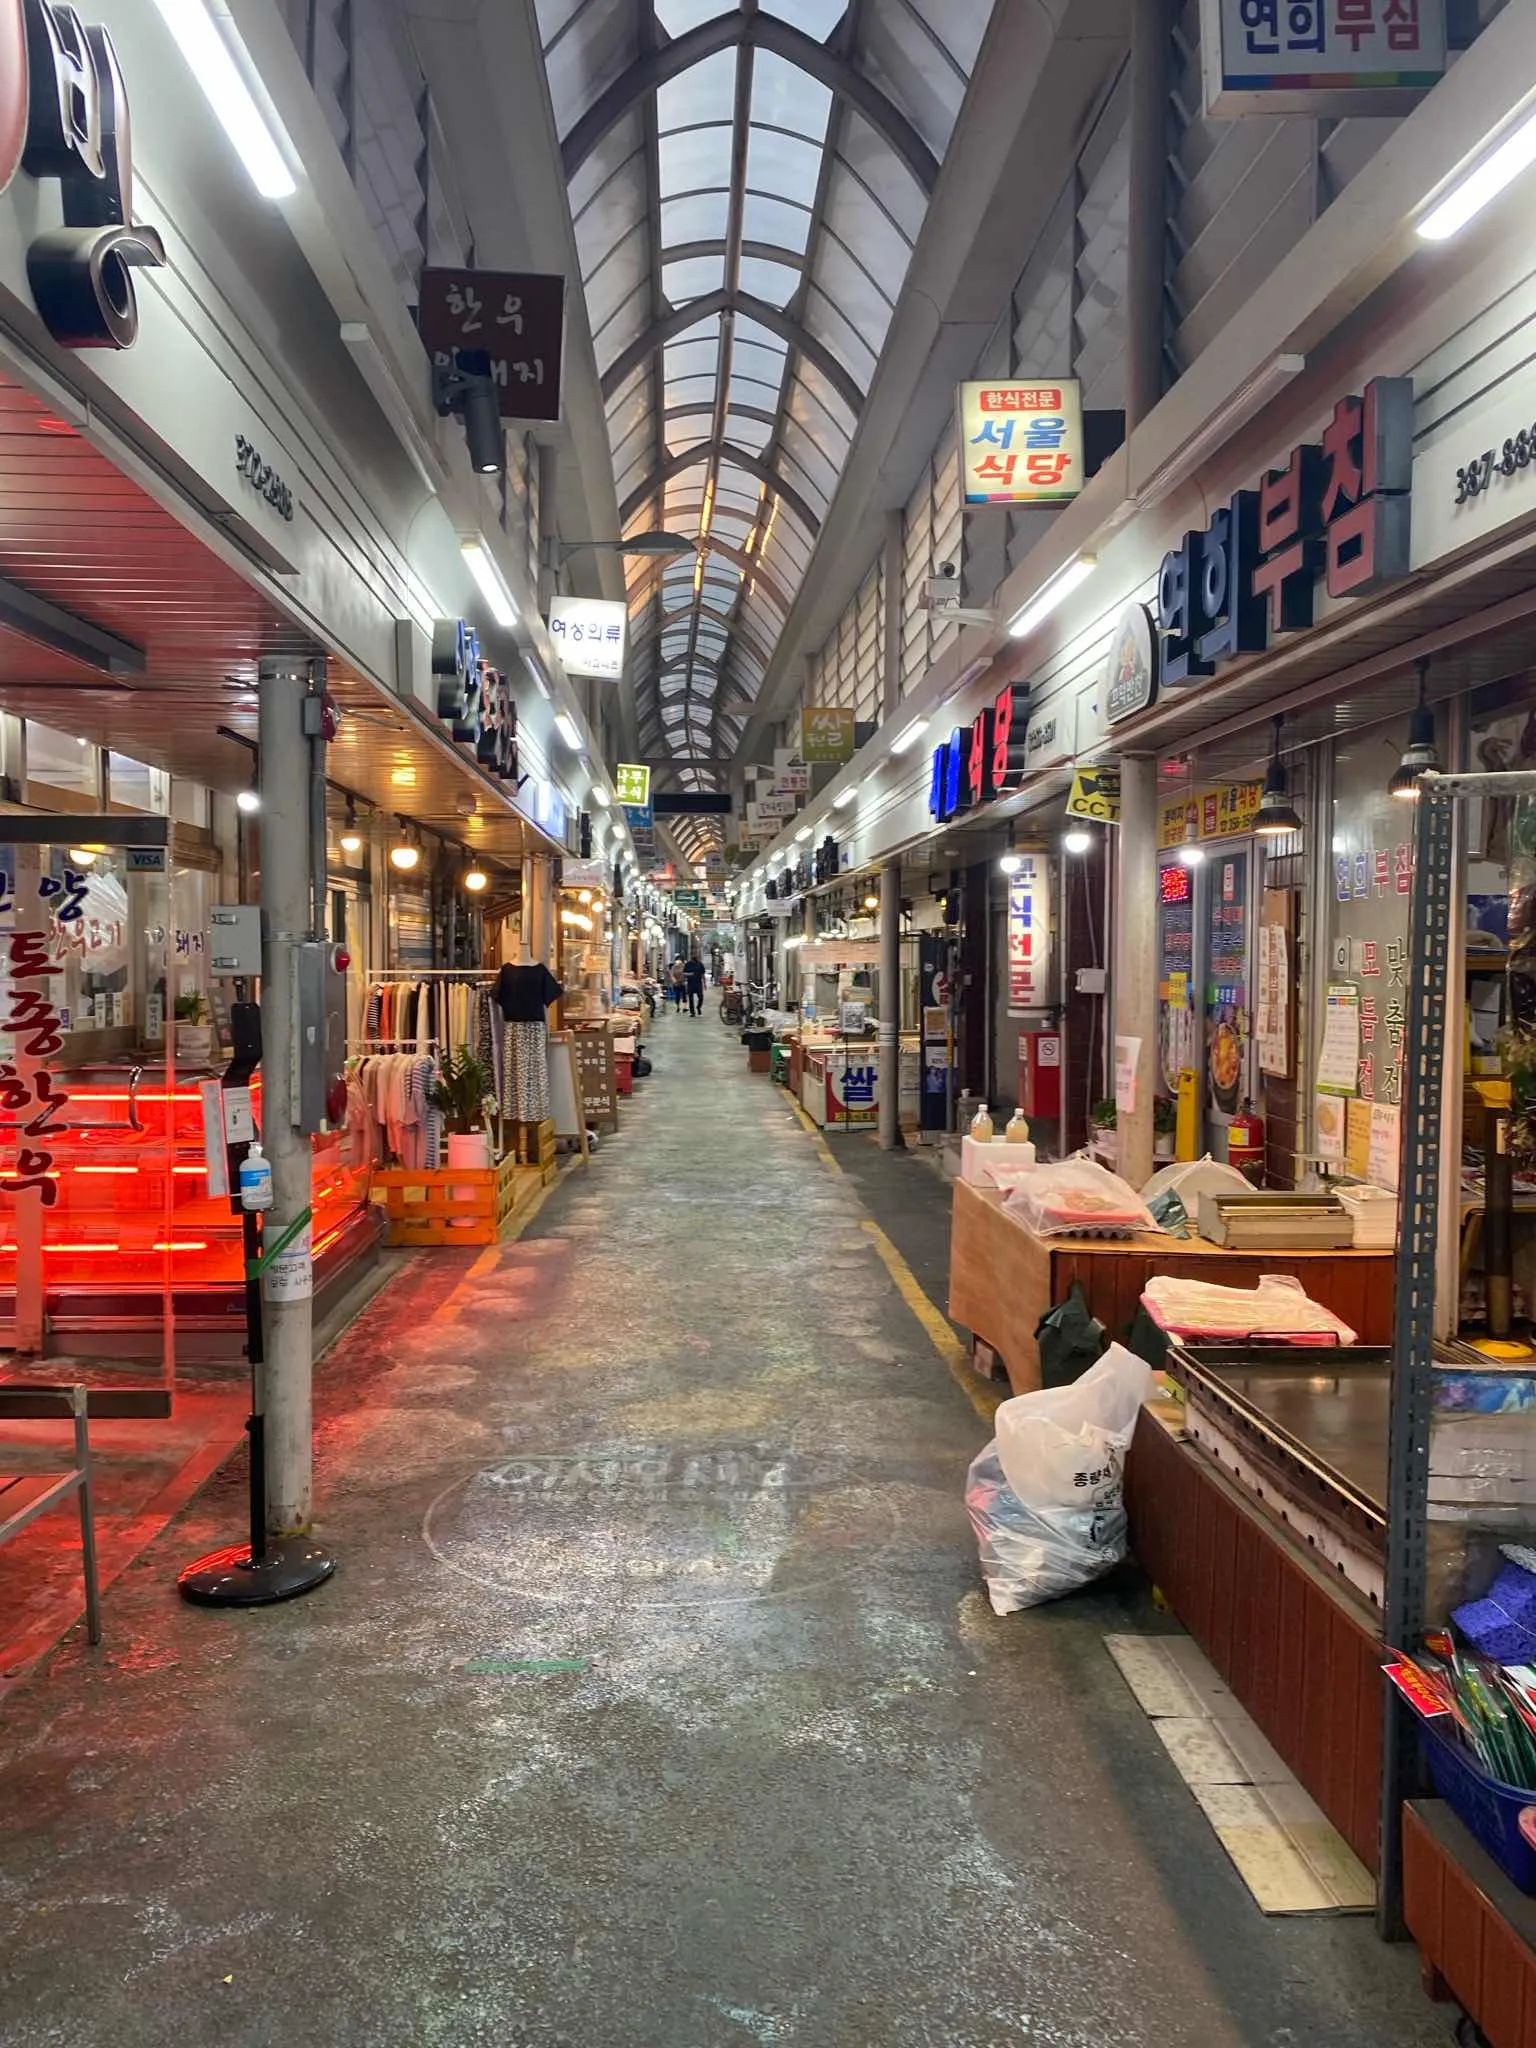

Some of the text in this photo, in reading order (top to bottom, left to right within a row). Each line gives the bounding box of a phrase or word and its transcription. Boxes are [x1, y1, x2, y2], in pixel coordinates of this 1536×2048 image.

[445, 284, 523, 336] 한우
[987, 390, 1055, 409] 한식전문
[969, 417, 1068, 450] 서울
[973, 452, 1072, 485] 식당
[1158, 376, 1405, 688] 연희부침
[552, 618, 620, 645] 여성의류
[1073, 797, 1120, 819] CCT
[133, 853, 161, 866] VISA
[1335, 844, 1414, 902] 연희부침
[840, 1065, 878, 1102] 쌀
